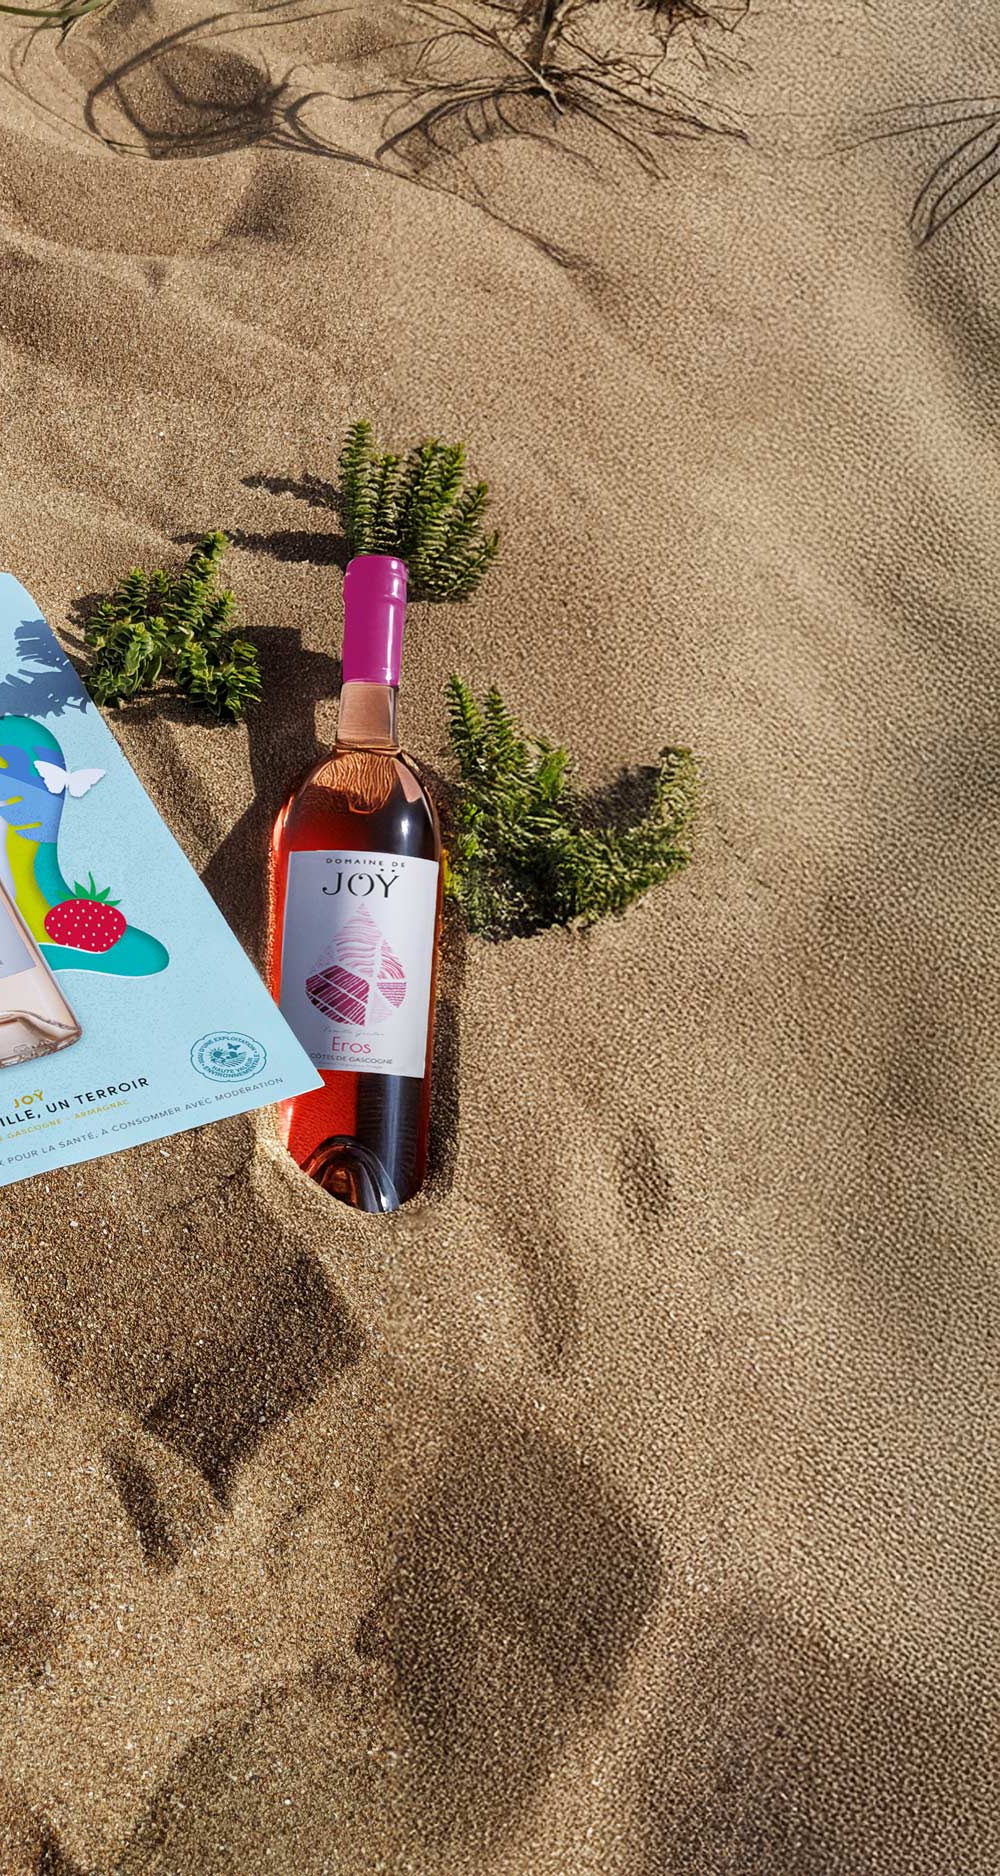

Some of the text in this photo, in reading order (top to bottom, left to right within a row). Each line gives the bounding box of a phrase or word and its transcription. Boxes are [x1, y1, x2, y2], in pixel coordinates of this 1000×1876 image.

[326, 858, 384, 866] DOMAINE
[322, 868, 399, 898] JOŸ
[331, 1036, 372, 1054] Eros
[212, 1065, 234, 1074] HAUTE
[13, 1089, 44, 1109] JOŸ
[46, 1099, 70, 1113] UN
[74, 1077, 149, 1105] TERROIR
[7, 1119, 63, 1140] GASCOGNE
[74, 1099, 130, 1119] ARMAGNAC
[7, 1150, 39, 1165] POUR
[42, 1145, 56, 1154] LA
[58, 1131, 99, 1149] SANTÉ,
[111, 1106, 182, 1132] CONSOMMER
[185, 1097, 213, 1111] AVEC
[215, 1077, 284, 1102] MODÉRATION
